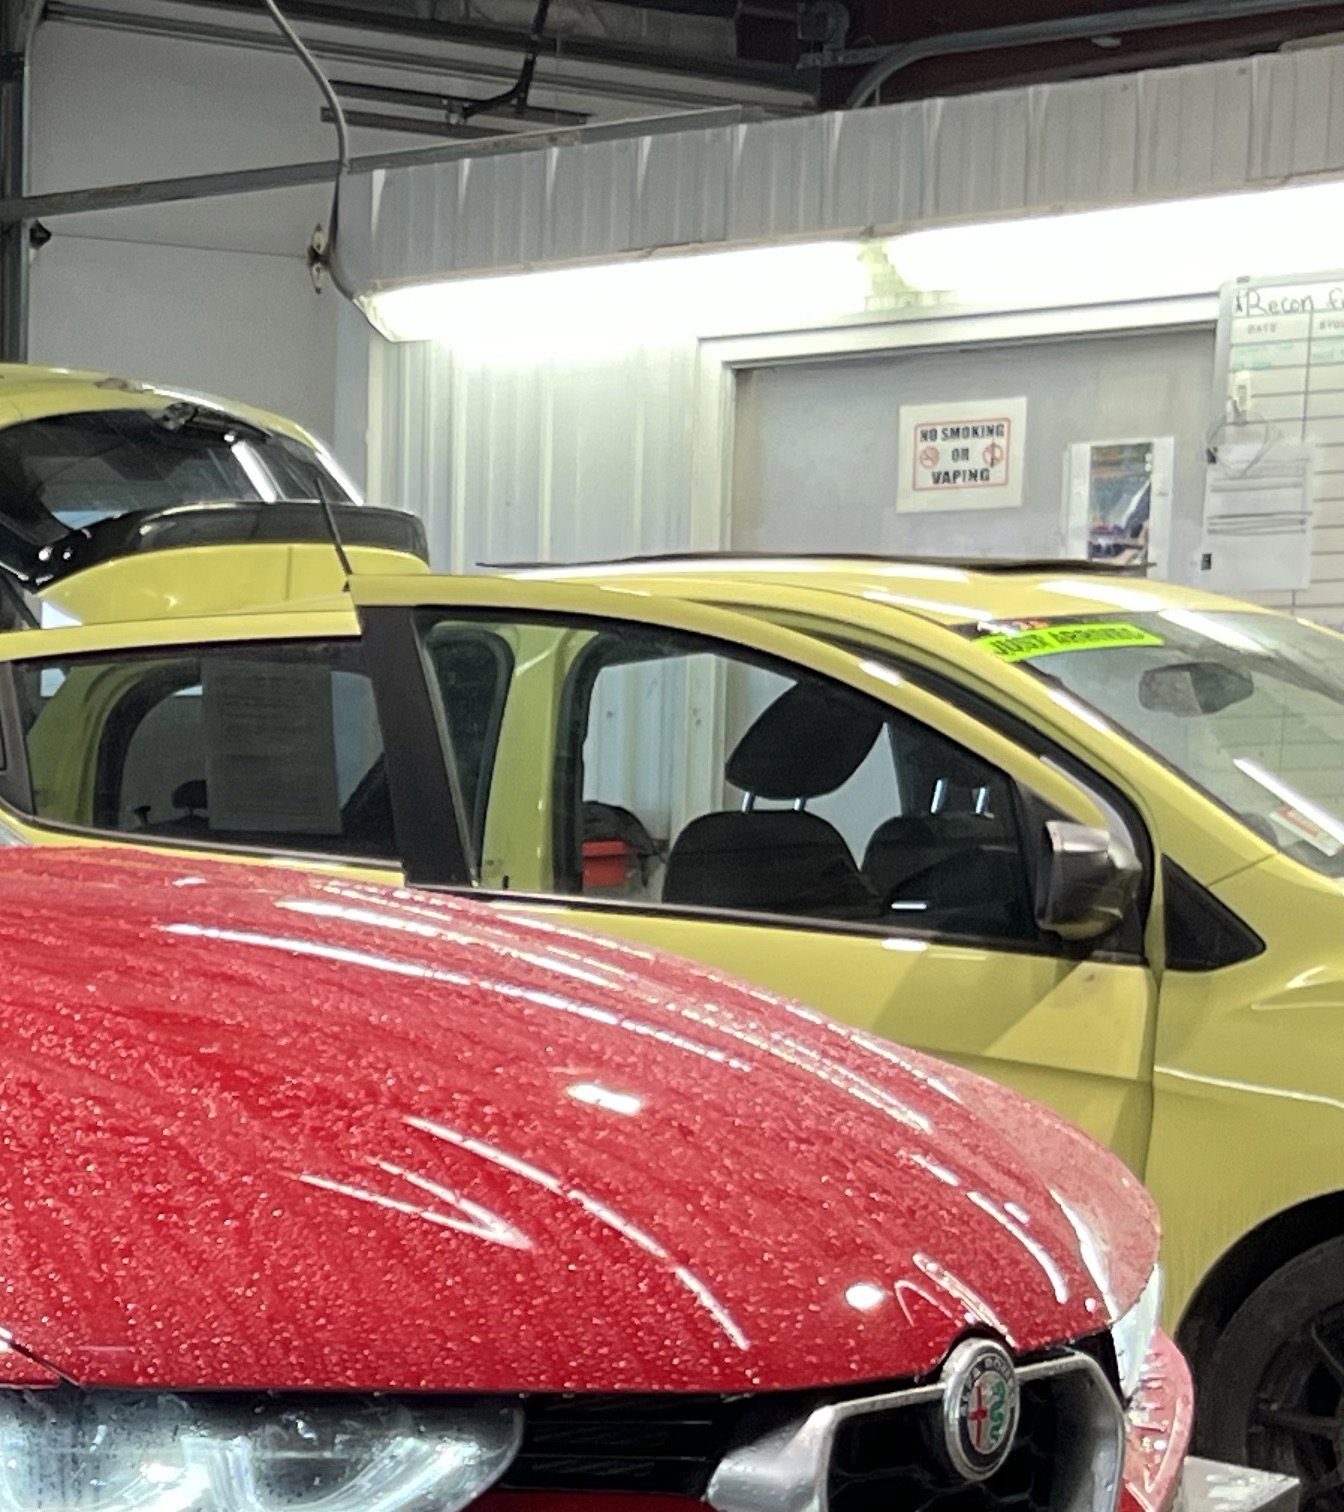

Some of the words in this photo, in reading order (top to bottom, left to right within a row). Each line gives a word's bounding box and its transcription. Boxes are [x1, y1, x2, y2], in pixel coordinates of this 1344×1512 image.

[1246, 288, 1313, 317] Recon
[920, 428, 938, 442] NO
[941, 424, 1005, 441] SMOKING
[951, 448, 970, 463] OR
[931, 468, 991, 485] VAPING
